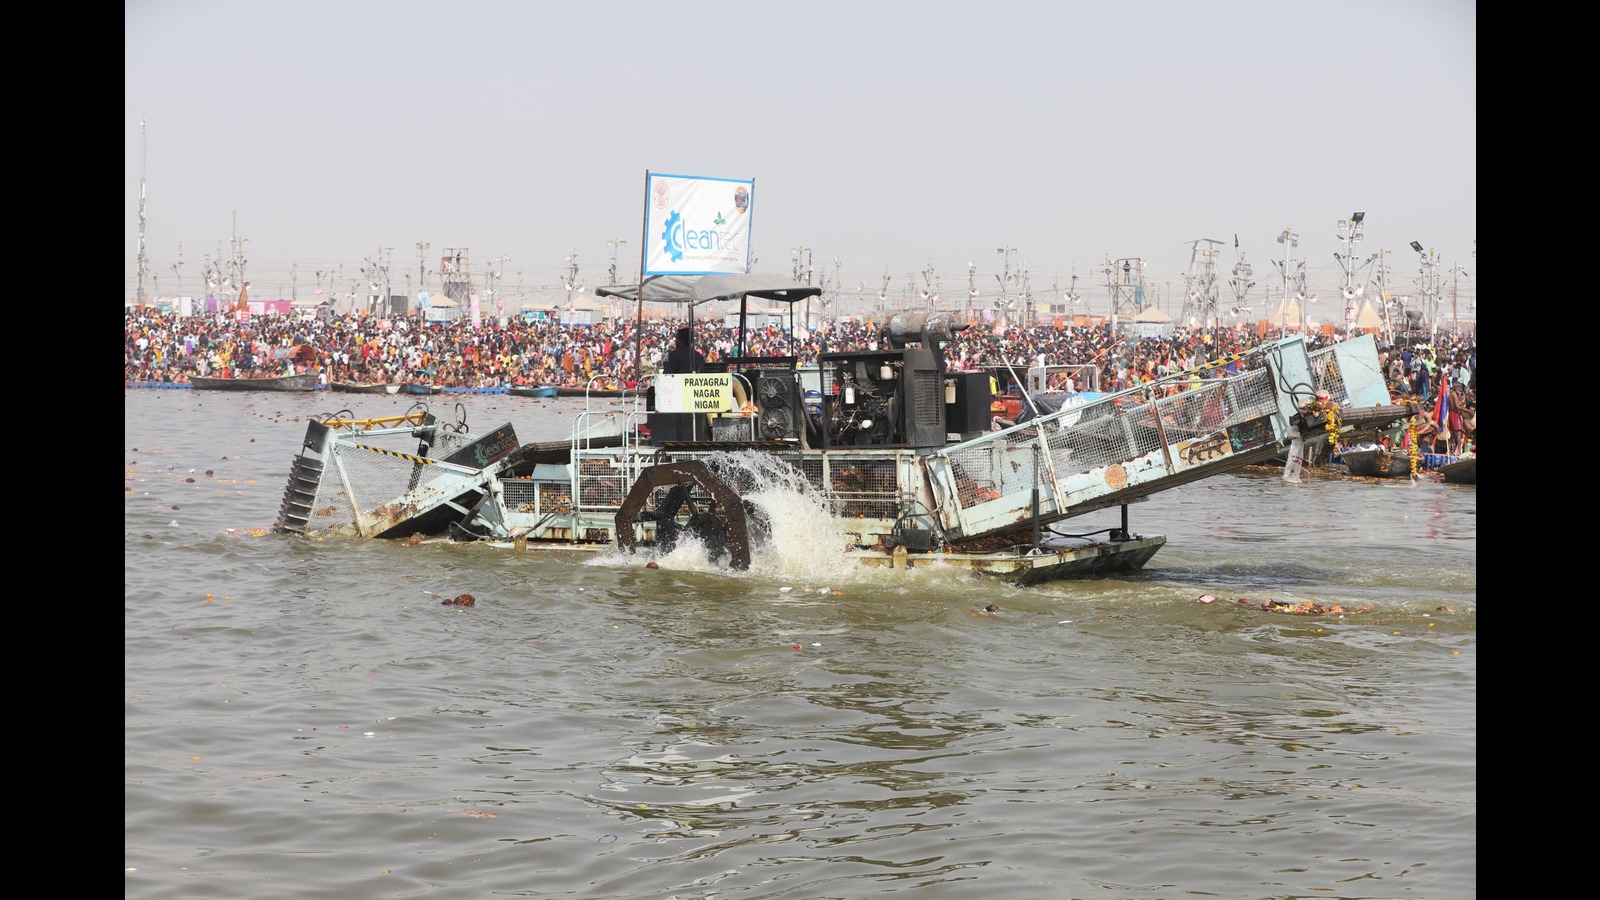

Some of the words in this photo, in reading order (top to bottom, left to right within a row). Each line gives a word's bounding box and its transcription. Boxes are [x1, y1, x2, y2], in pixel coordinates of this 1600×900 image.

[684, 378, 729, 387] PRAYAGRAJ
[693, 389, 720, 398] NAGAR
[694, 400, 720, 409] NIGAM
